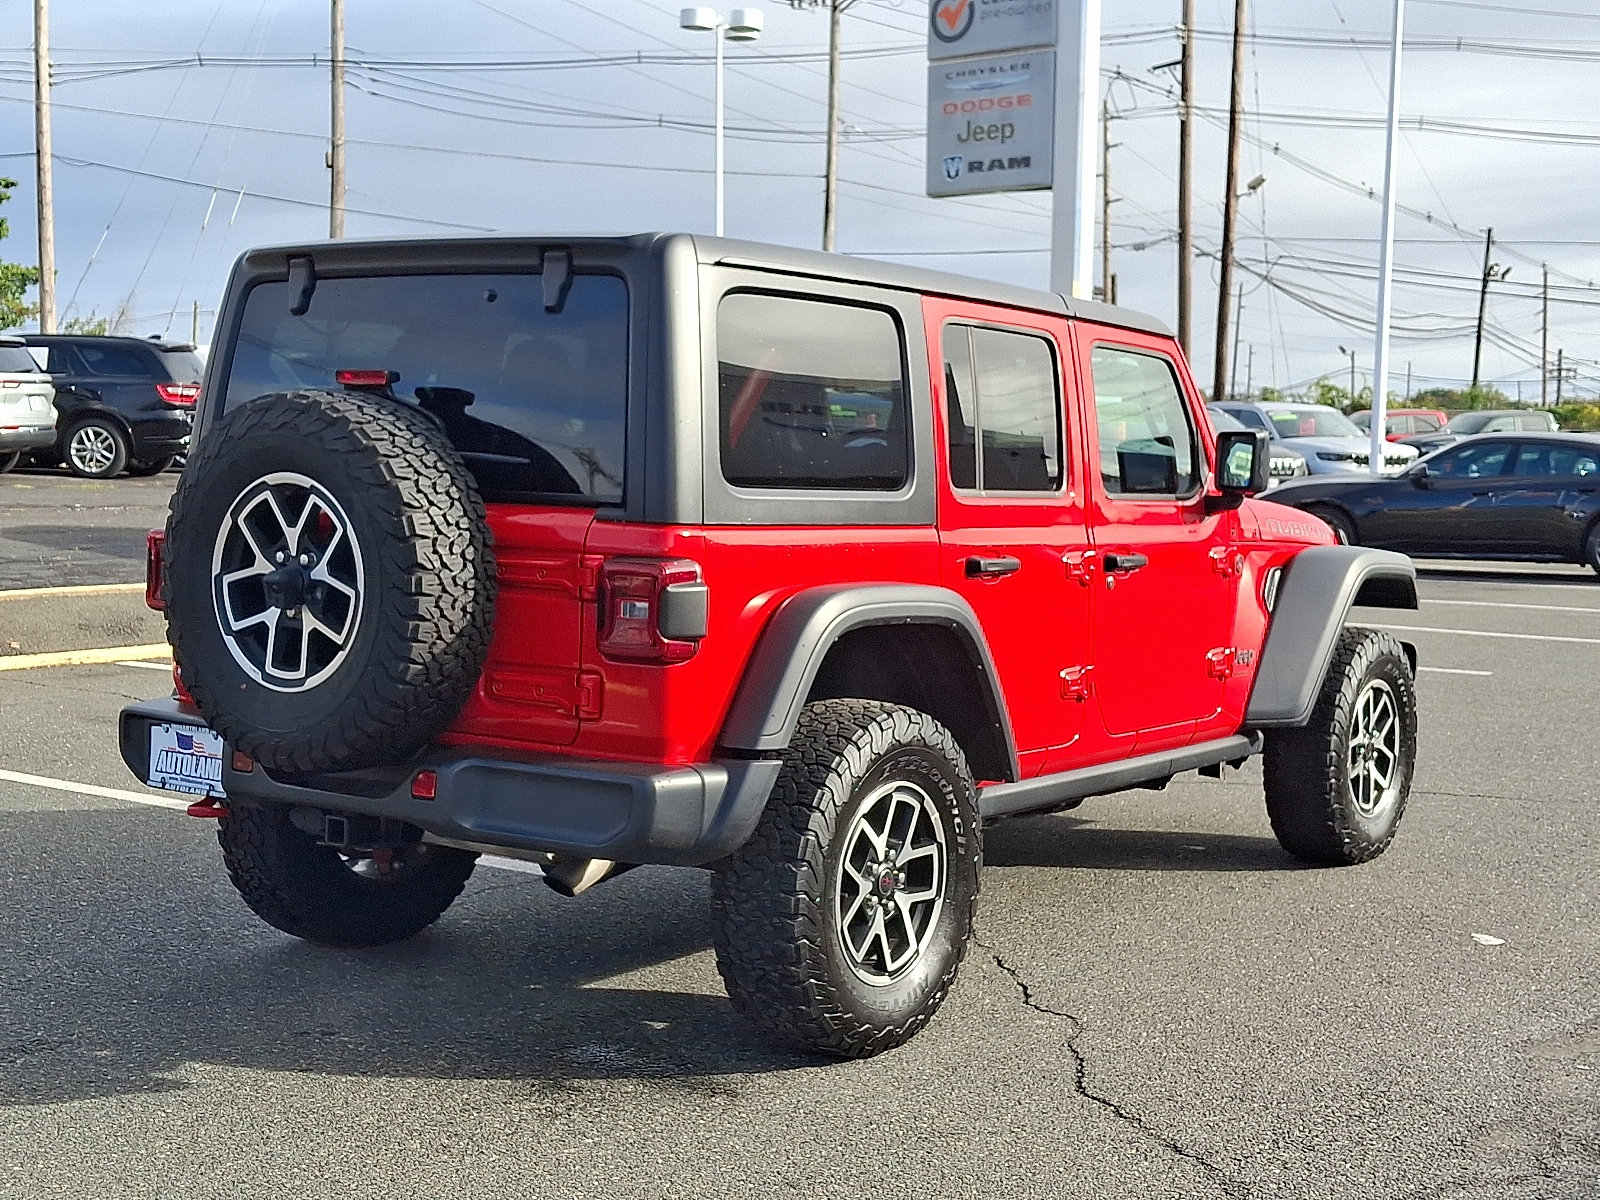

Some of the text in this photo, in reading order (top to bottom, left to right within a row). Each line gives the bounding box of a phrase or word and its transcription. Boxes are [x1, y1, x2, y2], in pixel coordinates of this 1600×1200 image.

[945, 62, 1031, 80] CHRYSLER
[942, 94, 1033, 115] DODGE
[957, 120, 1015, 144] Jeep
[967, 156, 1032, 174] RAM
[155, 750, 223, 783] AUTOLAND
[165, 783, 207, 796] AUTOLAND
